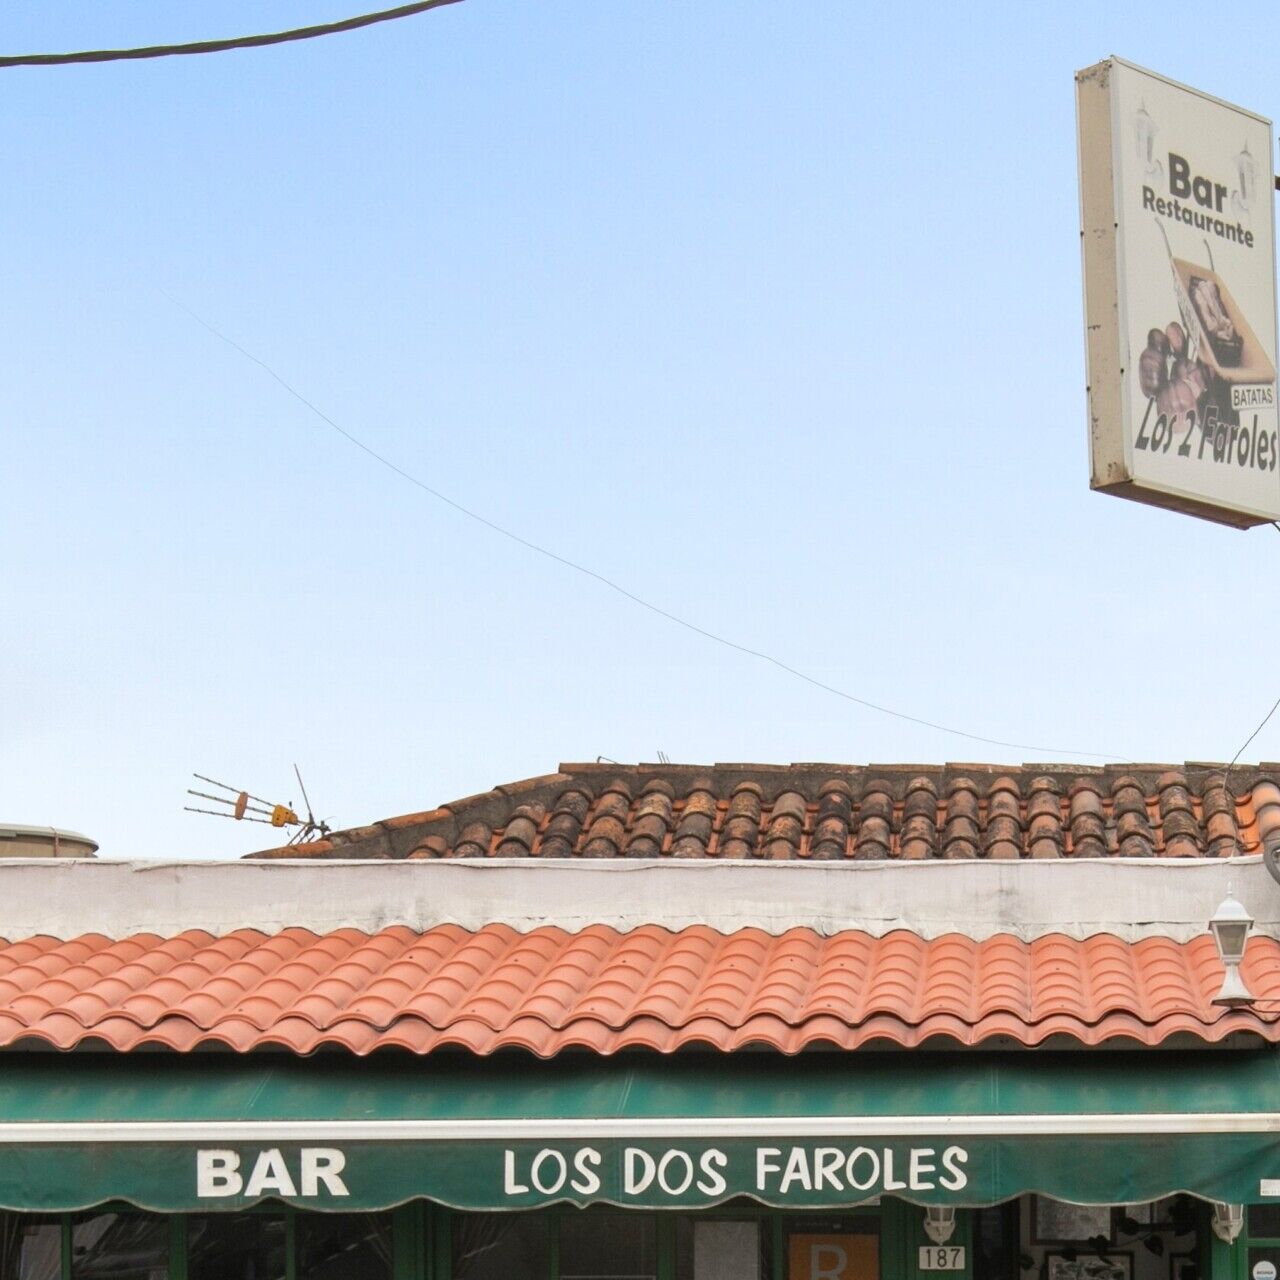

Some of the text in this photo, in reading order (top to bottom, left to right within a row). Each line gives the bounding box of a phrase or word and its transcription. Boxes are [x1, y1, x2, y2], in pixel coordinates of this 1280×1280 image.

[1167, 152, 1228, 213] Bar
[1142, 184, 1254, 248] Restaurante
[1234, 388, 1273, 407] BATATAS
[1135, 395, 1277, 473] Los 2 Faroles
[197, 1146, 968, 1197] BAR LOS DOS FAROLES
[926, 1248, 961, 1268] 187
